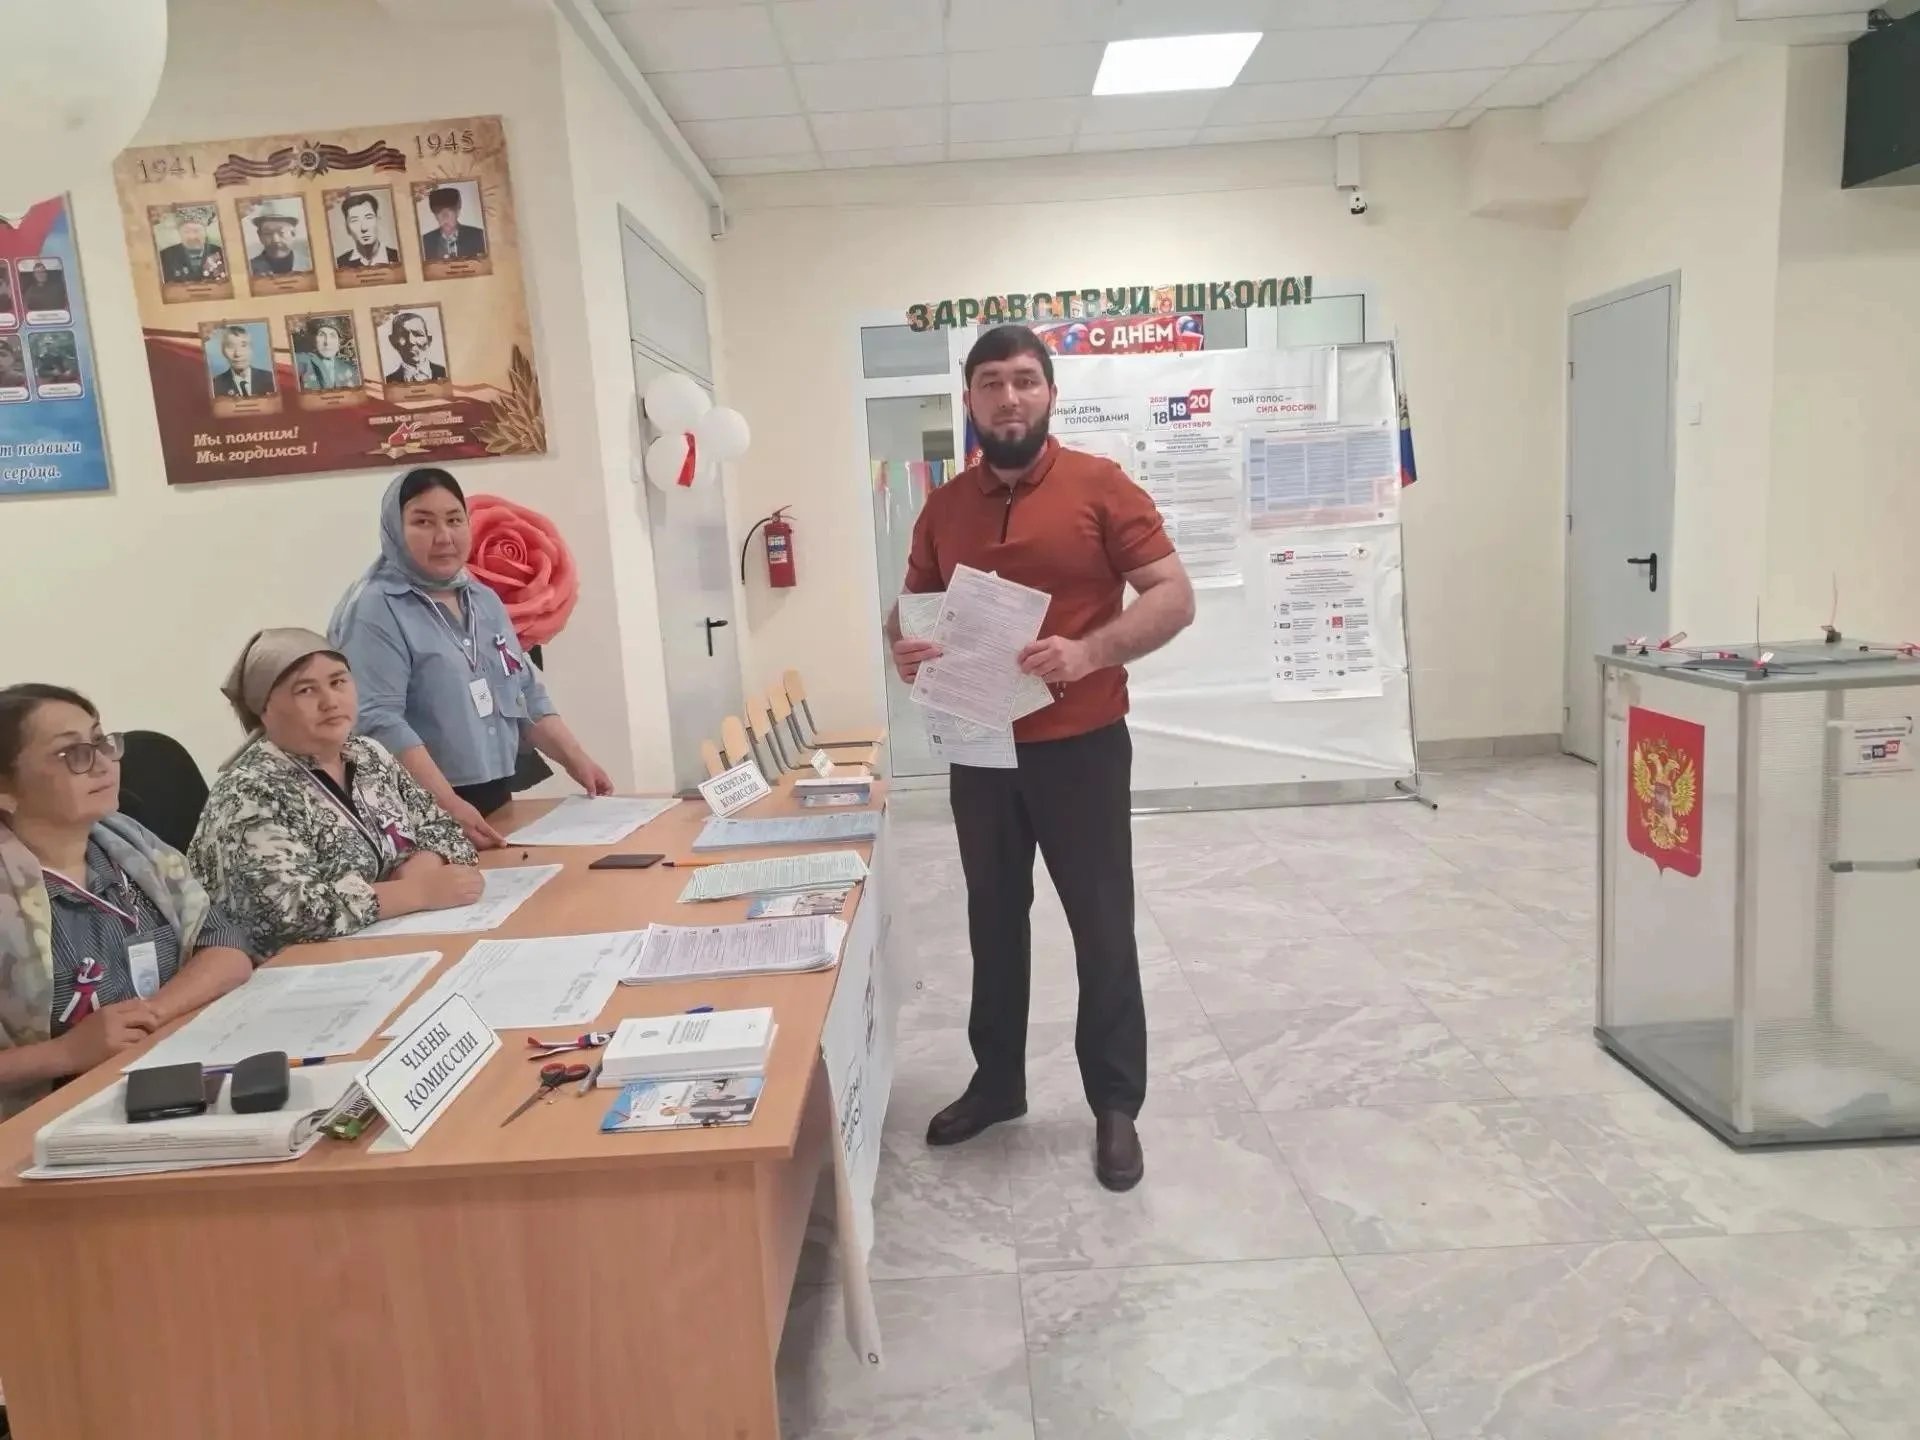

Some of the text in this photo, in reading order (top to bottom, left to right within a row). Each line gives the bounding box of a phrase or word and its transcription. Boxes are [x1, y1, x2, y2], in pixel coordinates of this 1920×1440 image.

[414, 128, 476, 159] 1945
[135, 155, 199, 184] 1941
[1175, 275, 1313, 313] ШКОЛА!
[1089, 323, 1174, 349] С ДНЕМ
[1079, 405, 1101, 414] ДЕНЬ
[1153, 394, 1209, 425] 18 19 20
[1232, 394, 1255, 405] ТВОЙ
[1256, 394, 1284, 403] ГОЛОС
[1256, 405, 1278, 414] СИЛА
[1064, 412, 1129, 425] ГОЛОСОВАНИЯ
[194, 425, 299, 447] Мы помним!
[17, 440, 82, 457] подвиги
[196, 450, 225, 464] Мы
[228, 444, 308, 463] гордимся
[3, 463, 62, 484] сердца.
[713, 771, 752, 796] СЕКРЕТАРЬ
[400, 1022, 451, 1071] ЧЛЕНЫ
[404, 1031, 479, 1111] КОМИССИИ
